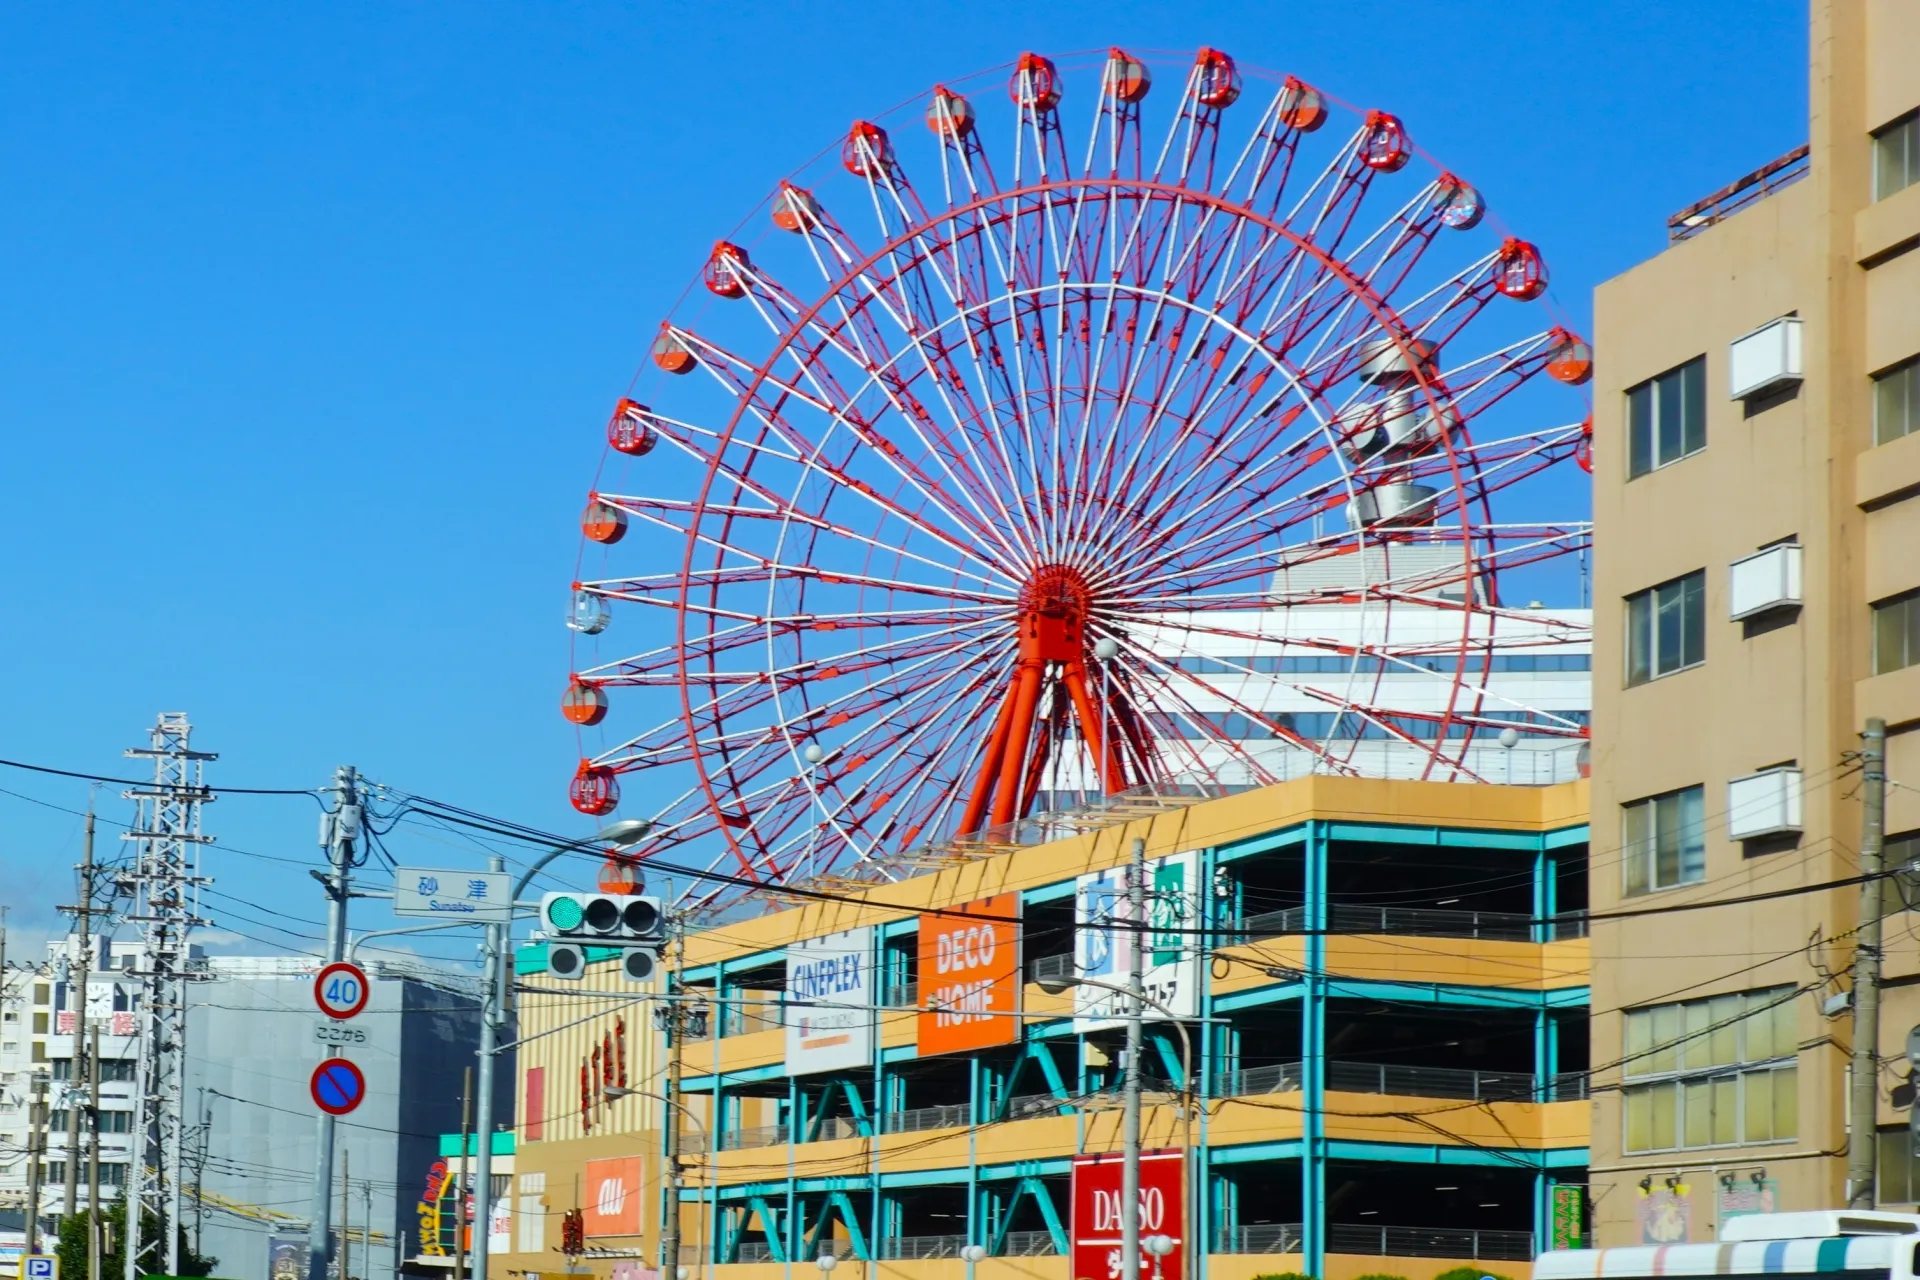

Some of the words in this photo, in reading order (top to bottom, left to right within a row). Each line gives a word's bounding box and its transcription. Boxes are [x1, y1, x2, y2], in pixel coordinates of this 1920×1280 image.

[418, 876, 488, 899] 砂津
[428, 899, 476, 913] Sunatsu
[936, 923, 997, 975] DECO
[326, 978, 357, 1005] 40
[793, 952, 862, 1001] CINEPLEX
[936, 978, 996, 1028] HOME
[315, 1026, 367, 1043] ここから
[597, 1177, 624, 1216] au
[1092, 1186, 1165, 1231] DASO
[31, 1260, 50, 1275] P
